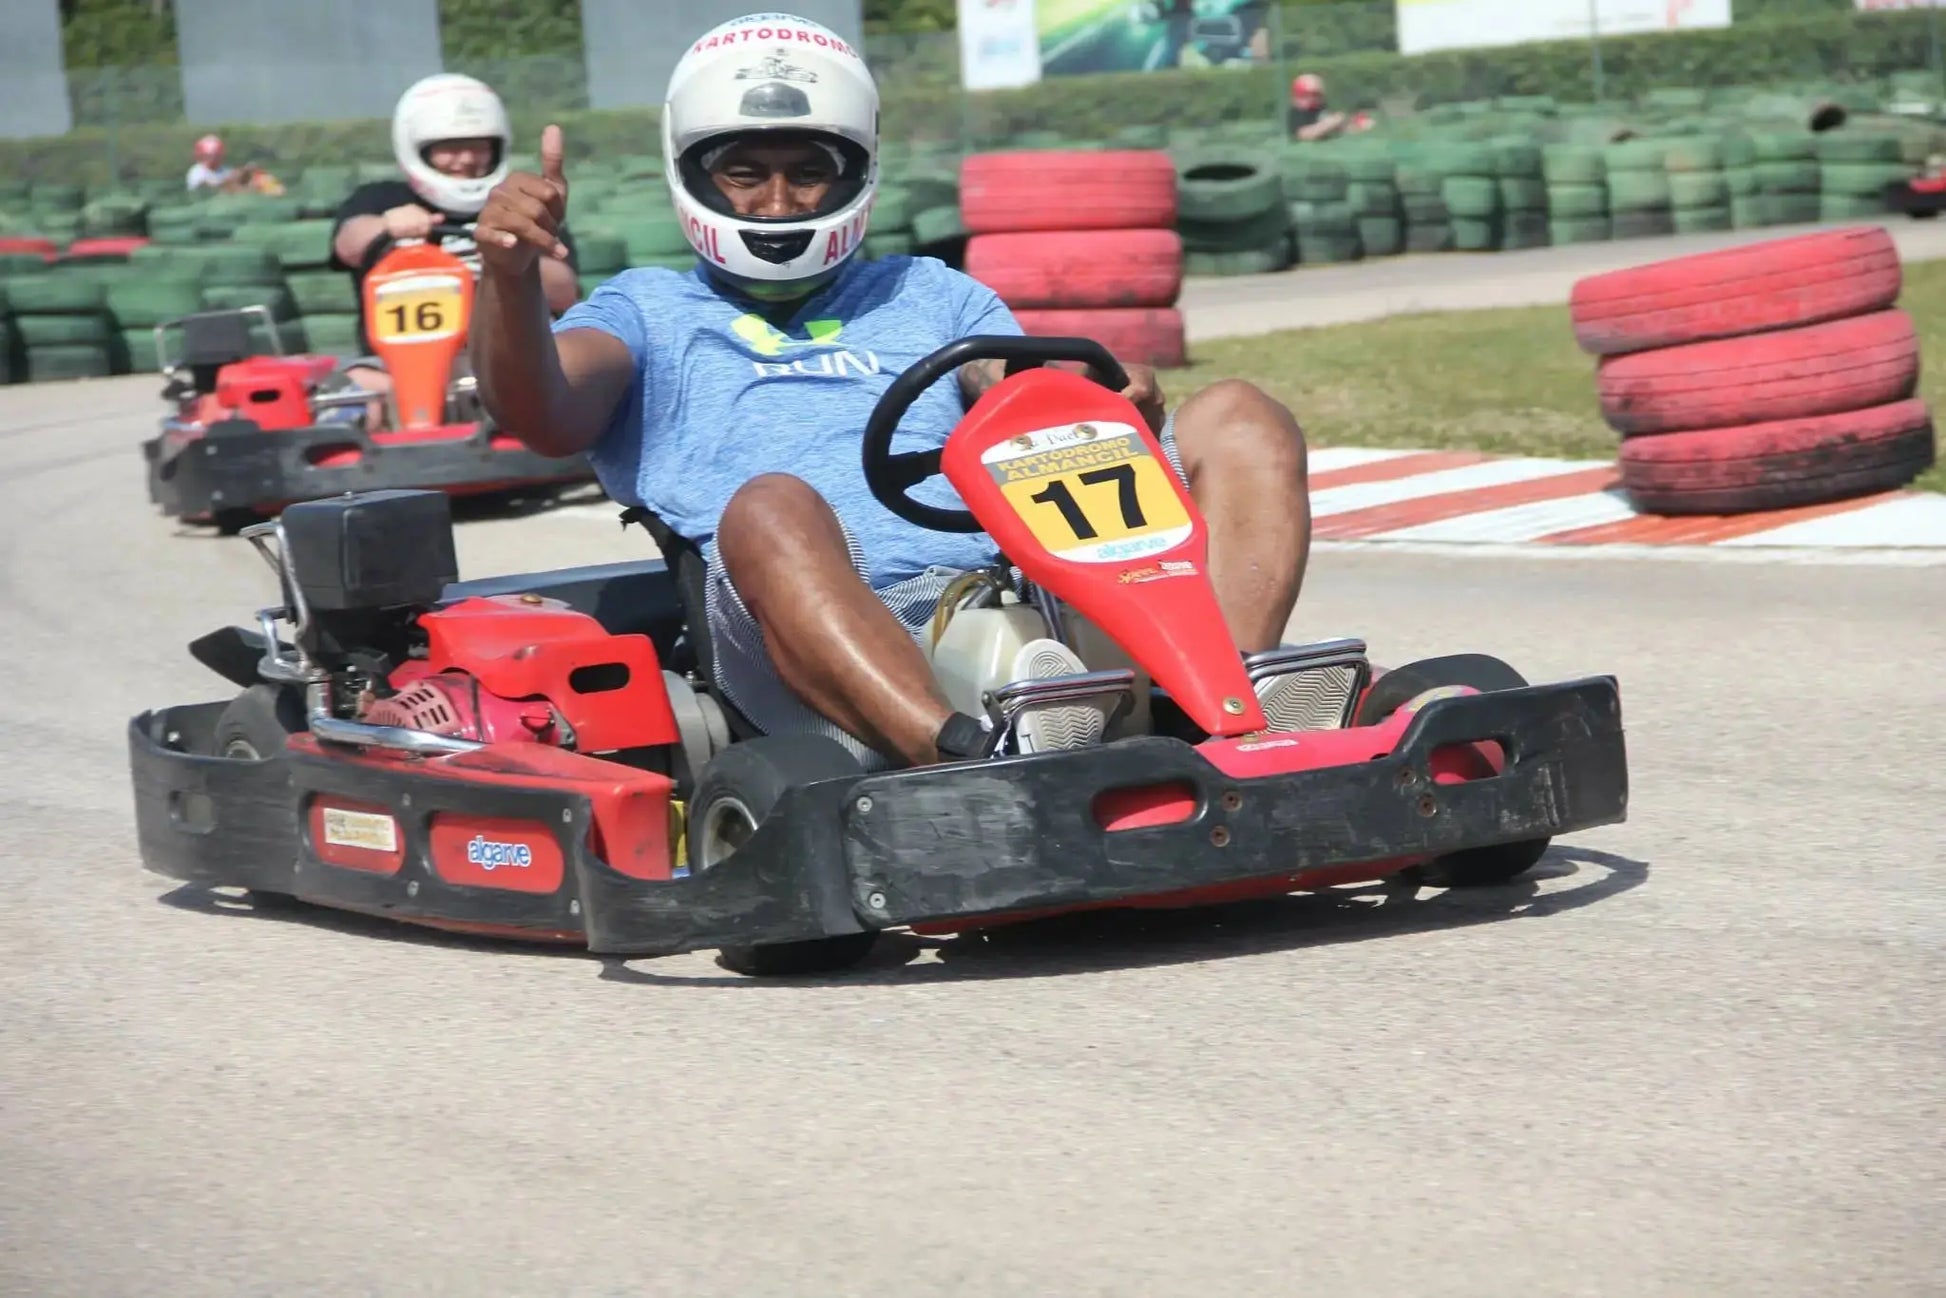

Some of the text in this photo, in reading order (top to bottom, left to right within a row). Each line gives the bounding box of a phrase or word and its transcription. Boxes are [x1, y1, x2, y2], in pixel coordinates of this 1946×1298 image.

[387, 302, 443, 333] 16
[752, 349, 880, 378] RUN
[995, 437, 1131, 472] KARTODROMO
[1006, 447, 1139, 482] ALMANCIL
[1030, 463, 1148, 541] 17
[467, 834, 532, 871] algarve
